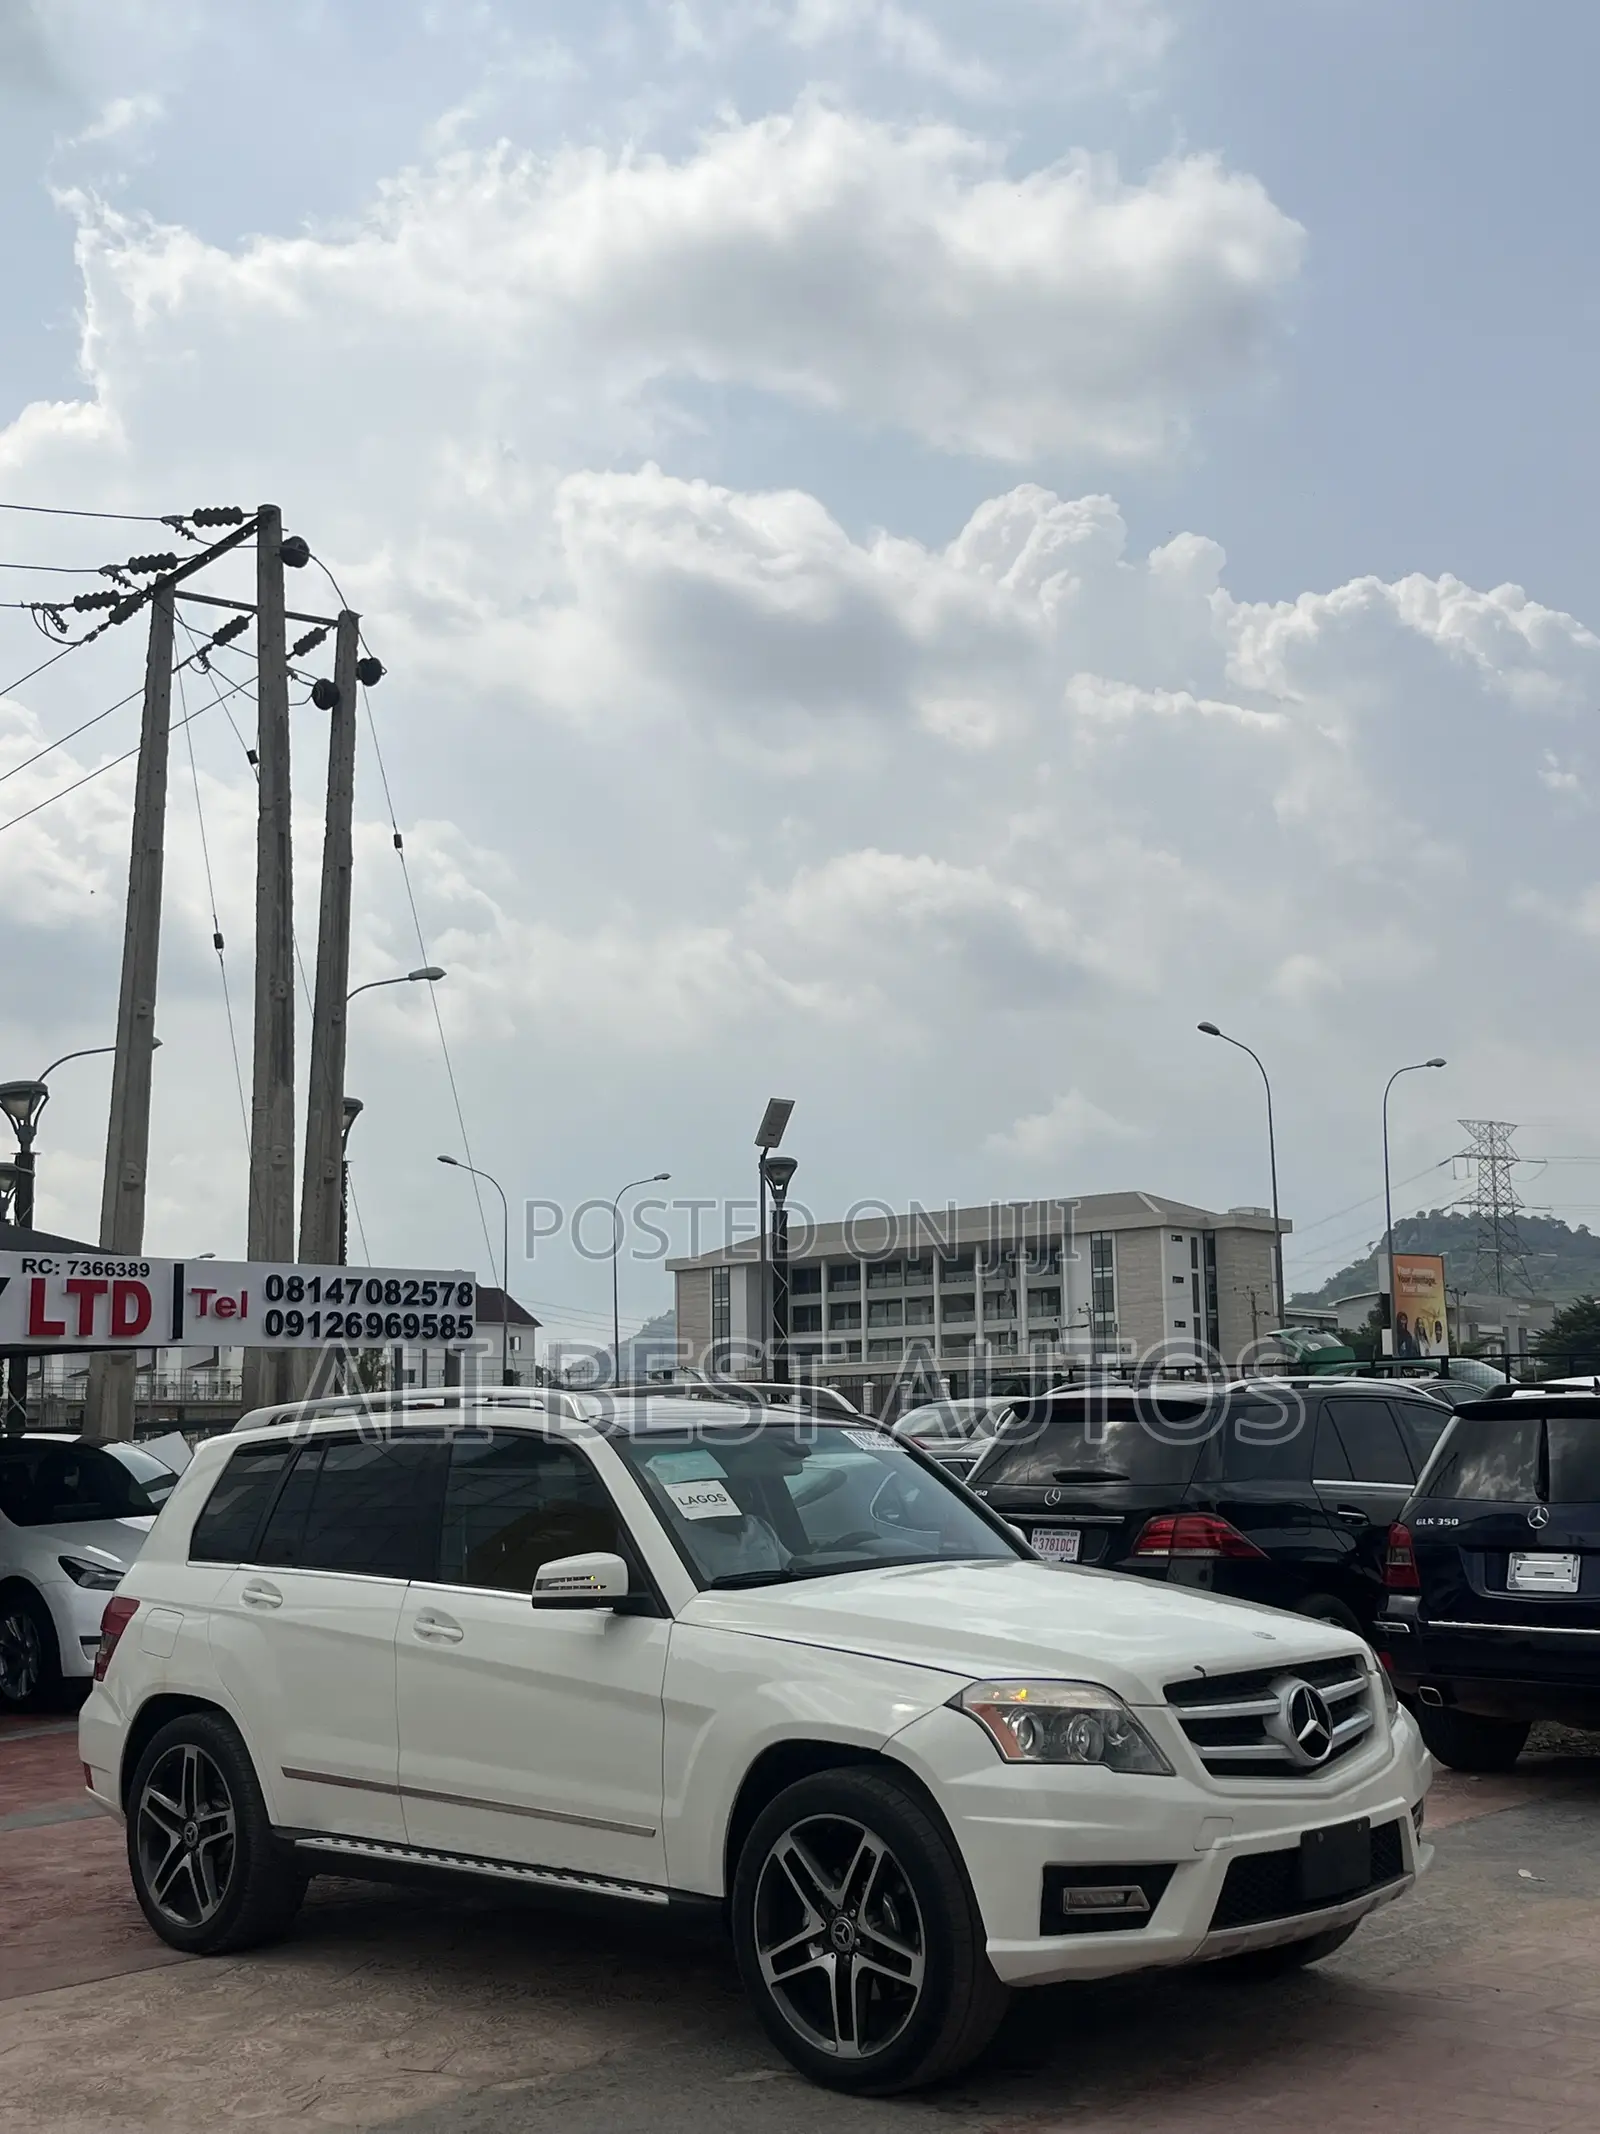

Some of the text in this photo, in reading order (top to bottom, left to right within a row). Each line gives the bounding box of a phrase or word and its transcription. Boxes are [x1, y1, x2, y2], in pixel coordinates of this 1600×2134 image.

[22, 1258, 150, 1277] RC: 7366389
[191, 1288, 249, 1318] Tel
[265, 1274, 473, 1307] 08147082578
[28, 1277, 153, 1336] LTD
[265, 1309, 473, 1339] 09126969585
[677, 1493, 727, 1506] LAGOS
[1416, 1517, 1459, 1526] GLK 350
